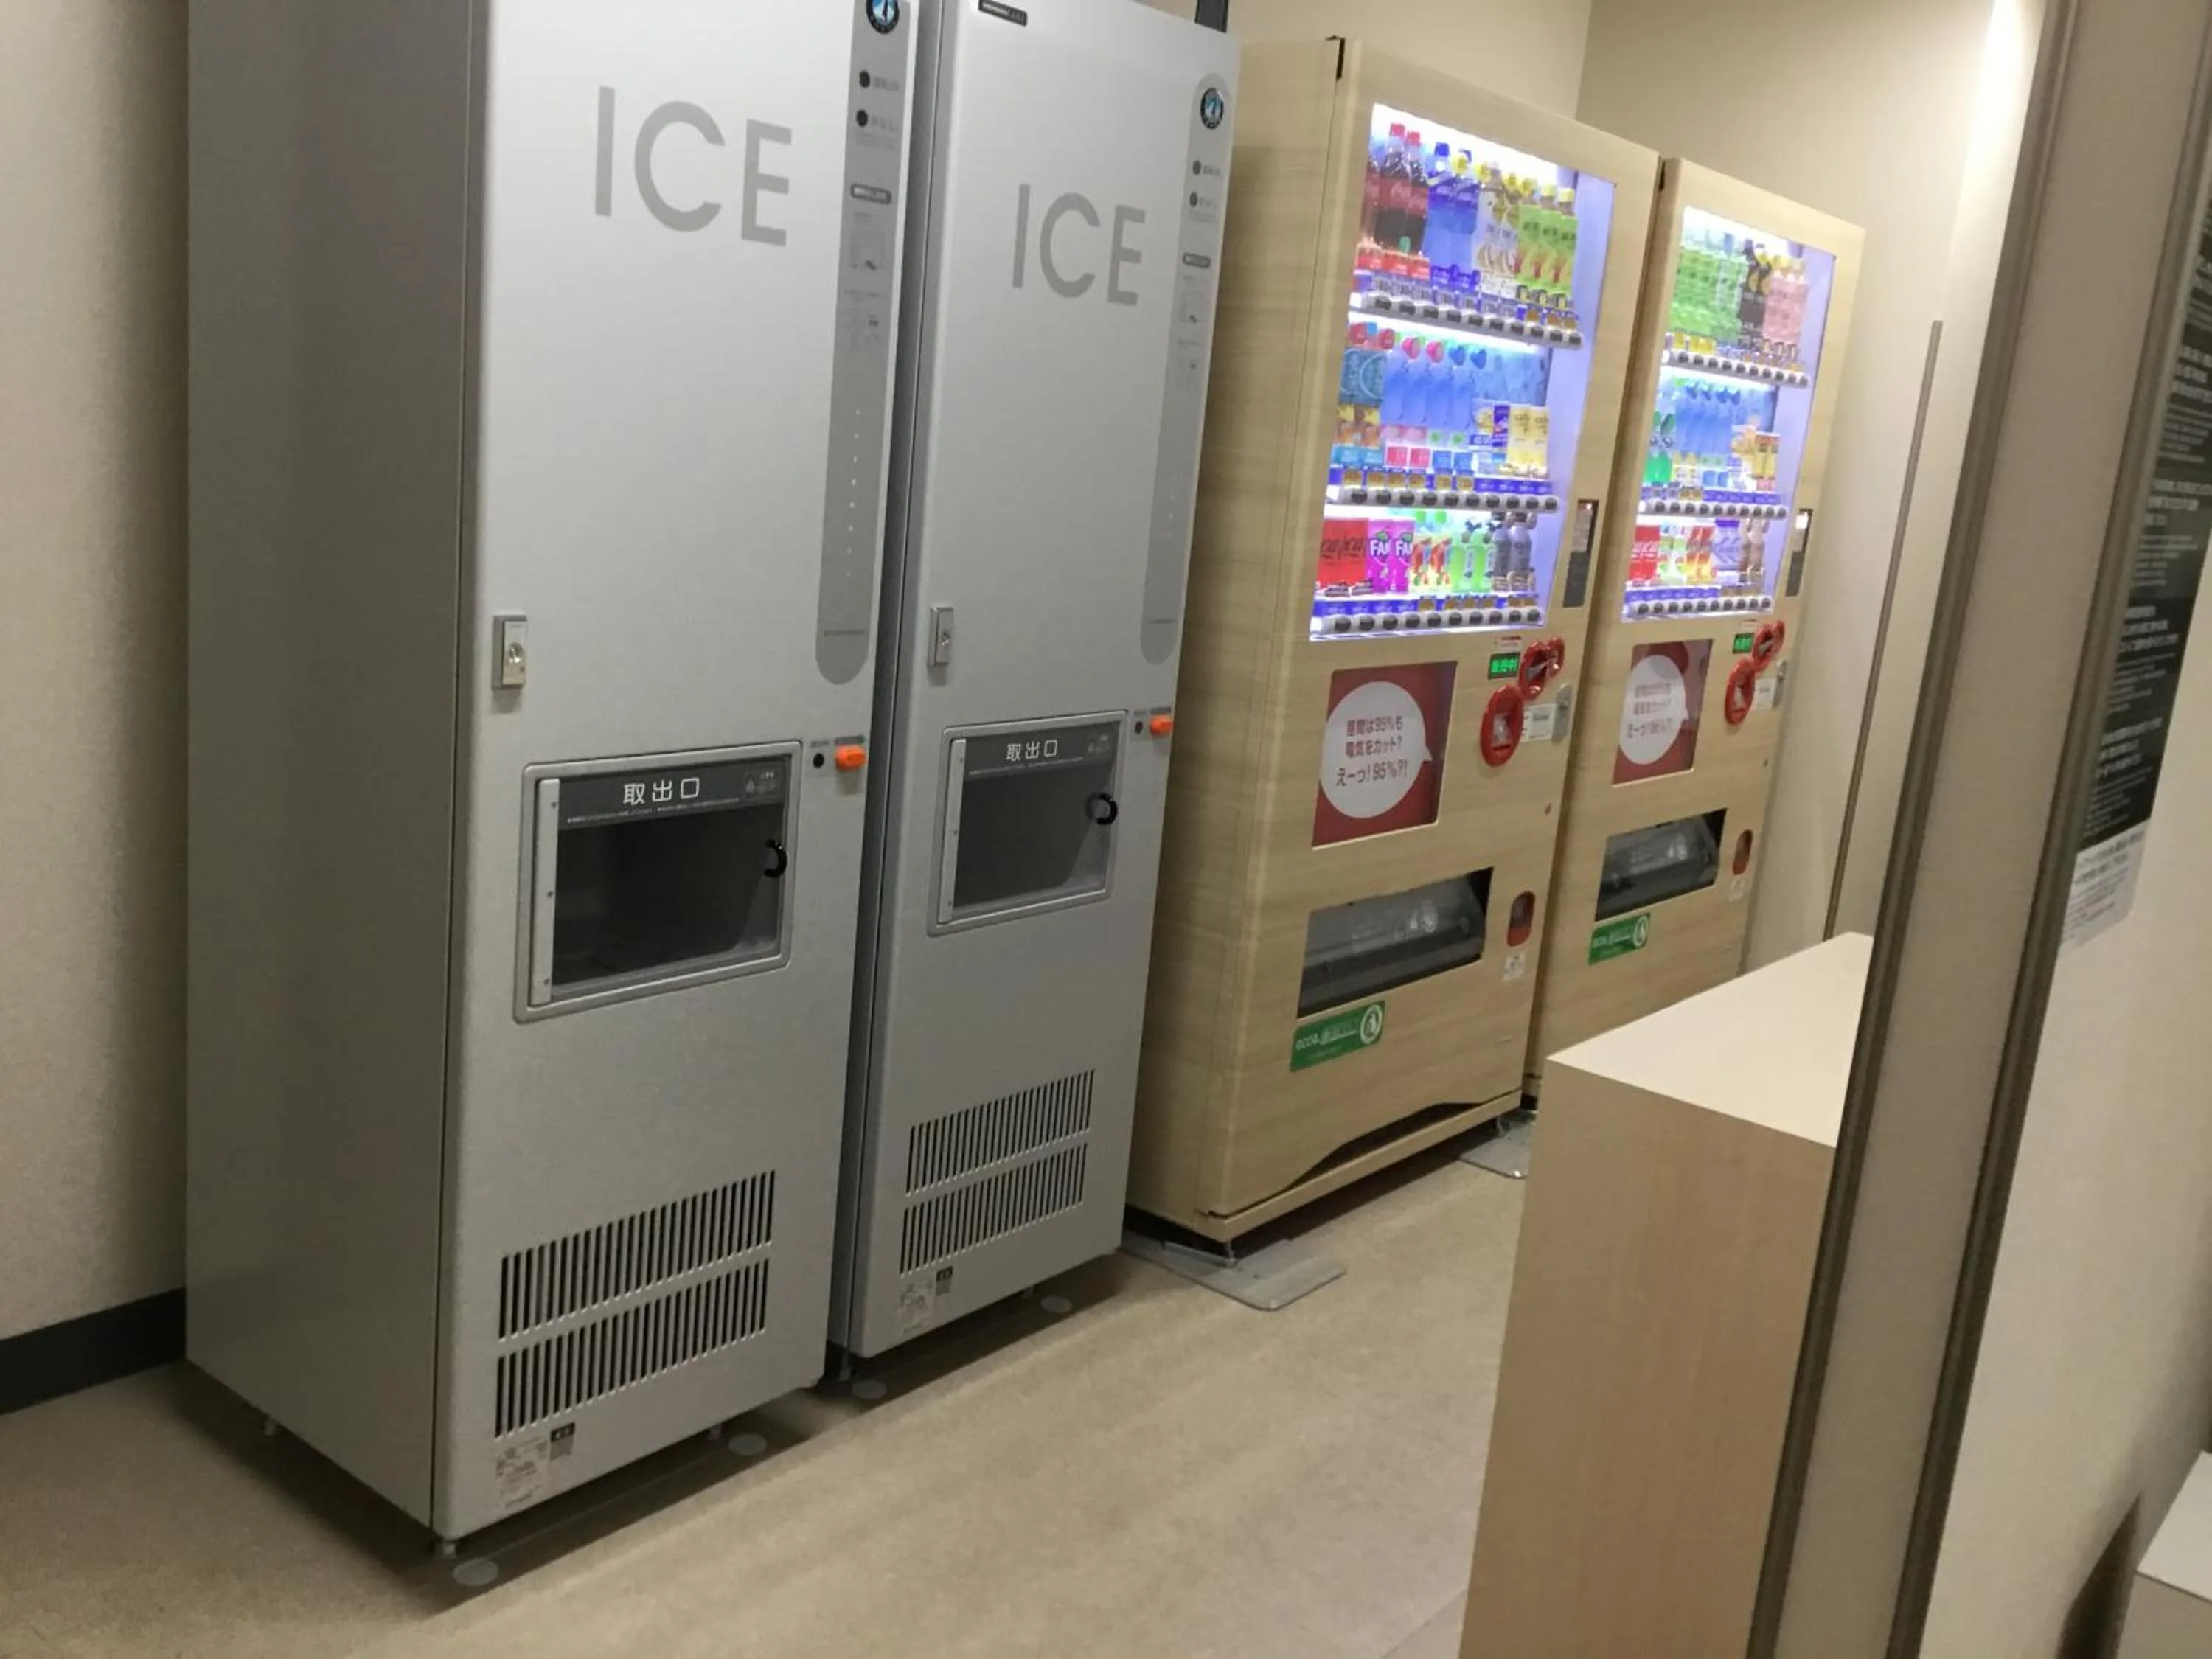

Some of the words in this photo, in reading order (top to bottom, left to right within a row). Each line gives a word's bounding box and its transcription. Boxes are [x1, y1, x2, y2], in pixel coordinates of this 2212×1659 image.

[594, 86, 792, 246] ICE
[1012, 183, 1147, 307] ICE
[1006, 739, 1059, 762] 取出口
[622, 776, 700, 806] 取出口
